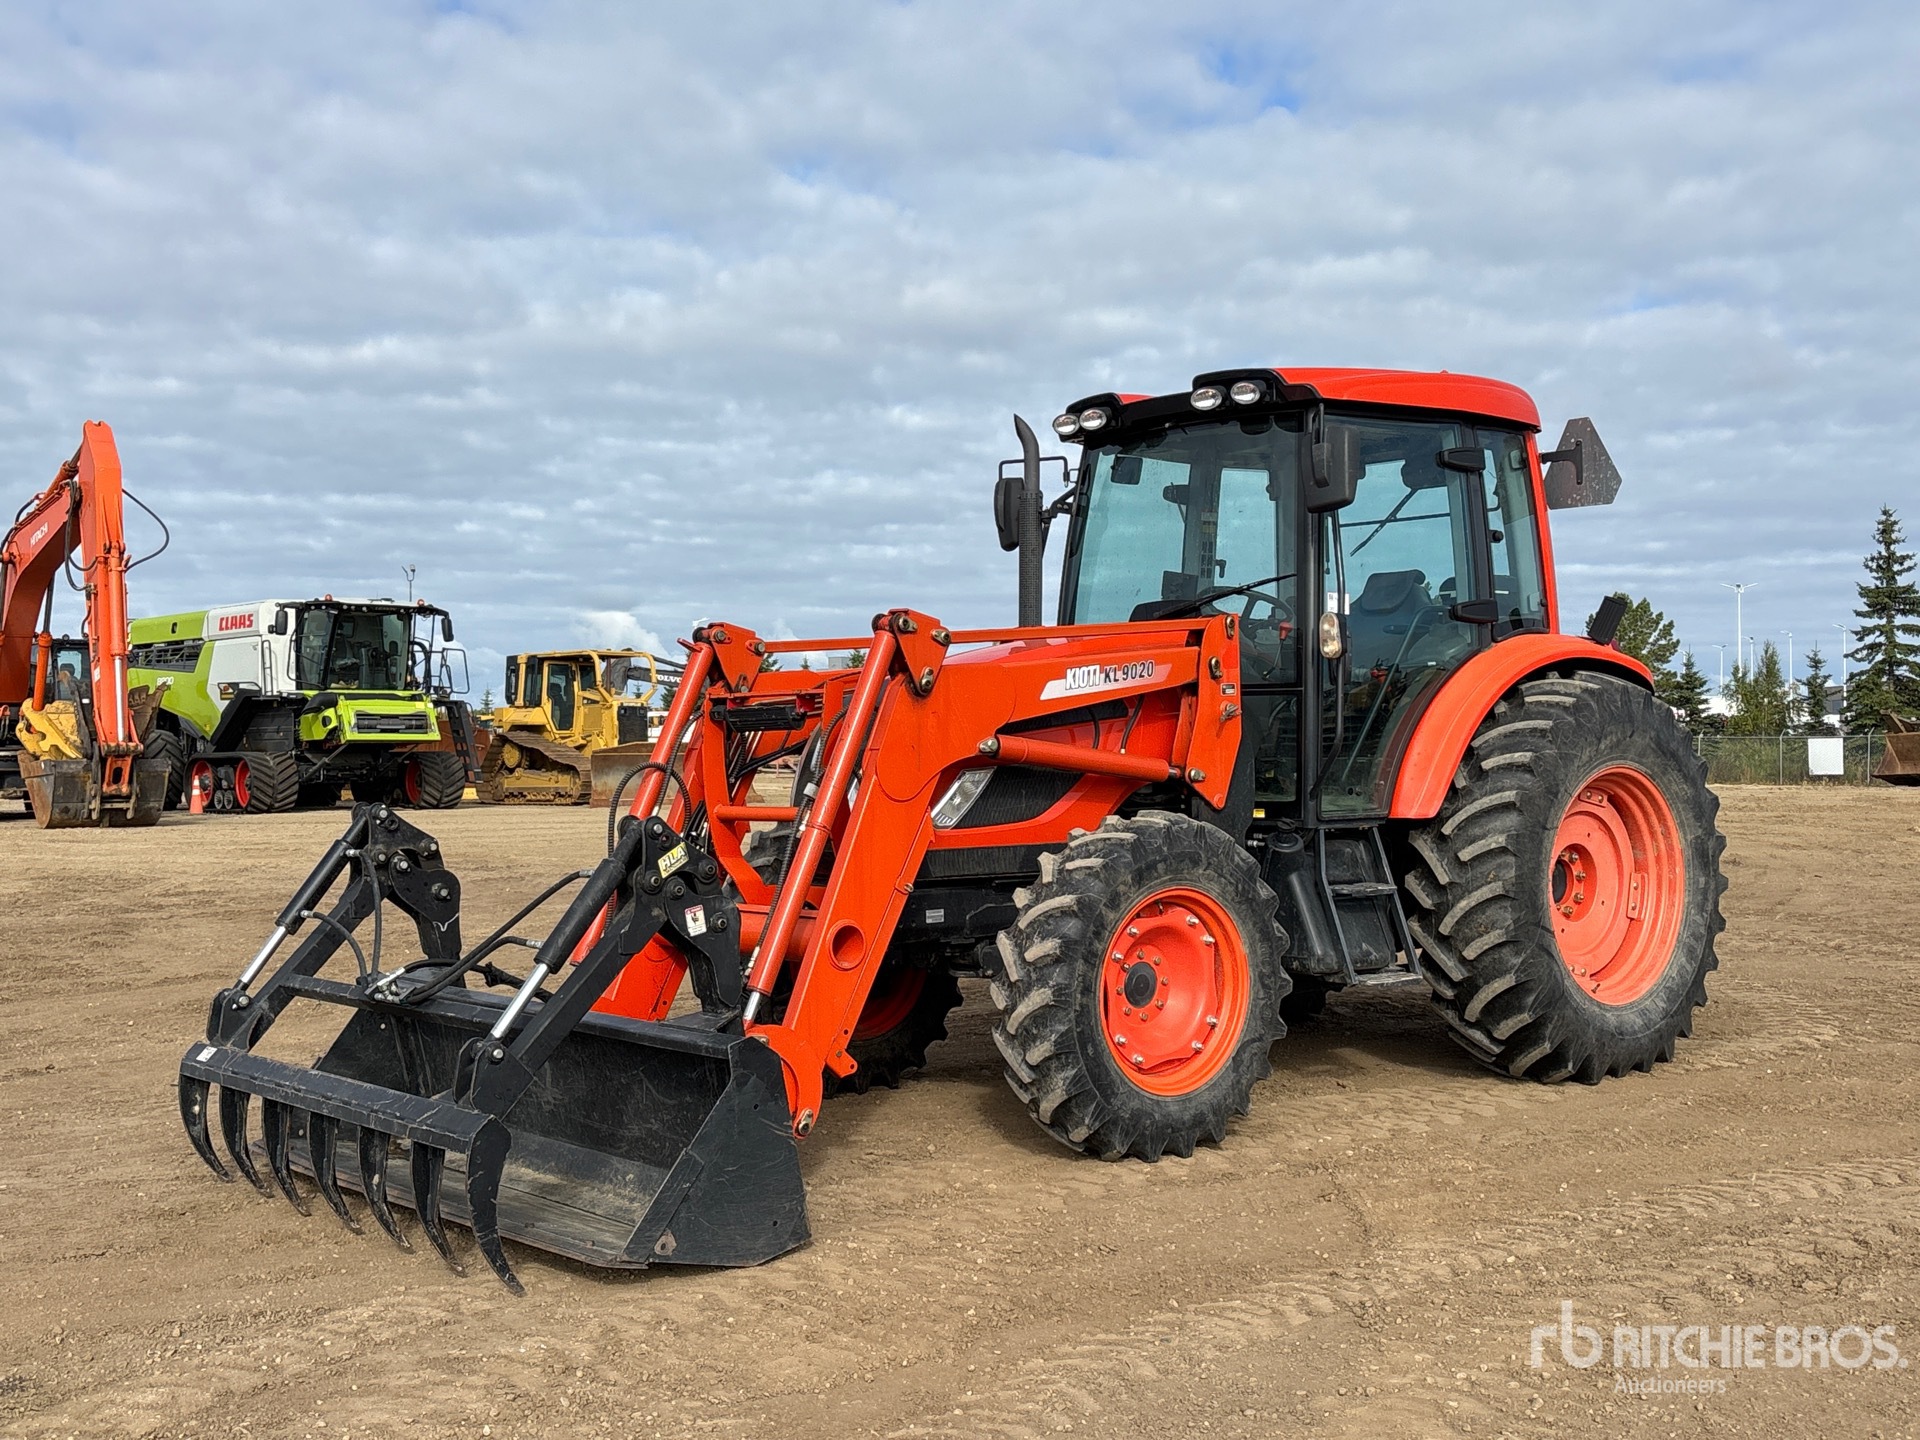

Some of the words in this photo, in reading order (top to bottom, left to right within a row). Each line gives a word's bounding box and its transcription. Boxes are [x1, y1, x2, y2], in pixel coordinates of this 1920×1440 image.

[218, 613, 254, 632] CLAAS
[1065, 664, 1100, 690] KIOTI
[660, 845, 687, 871] HLA
